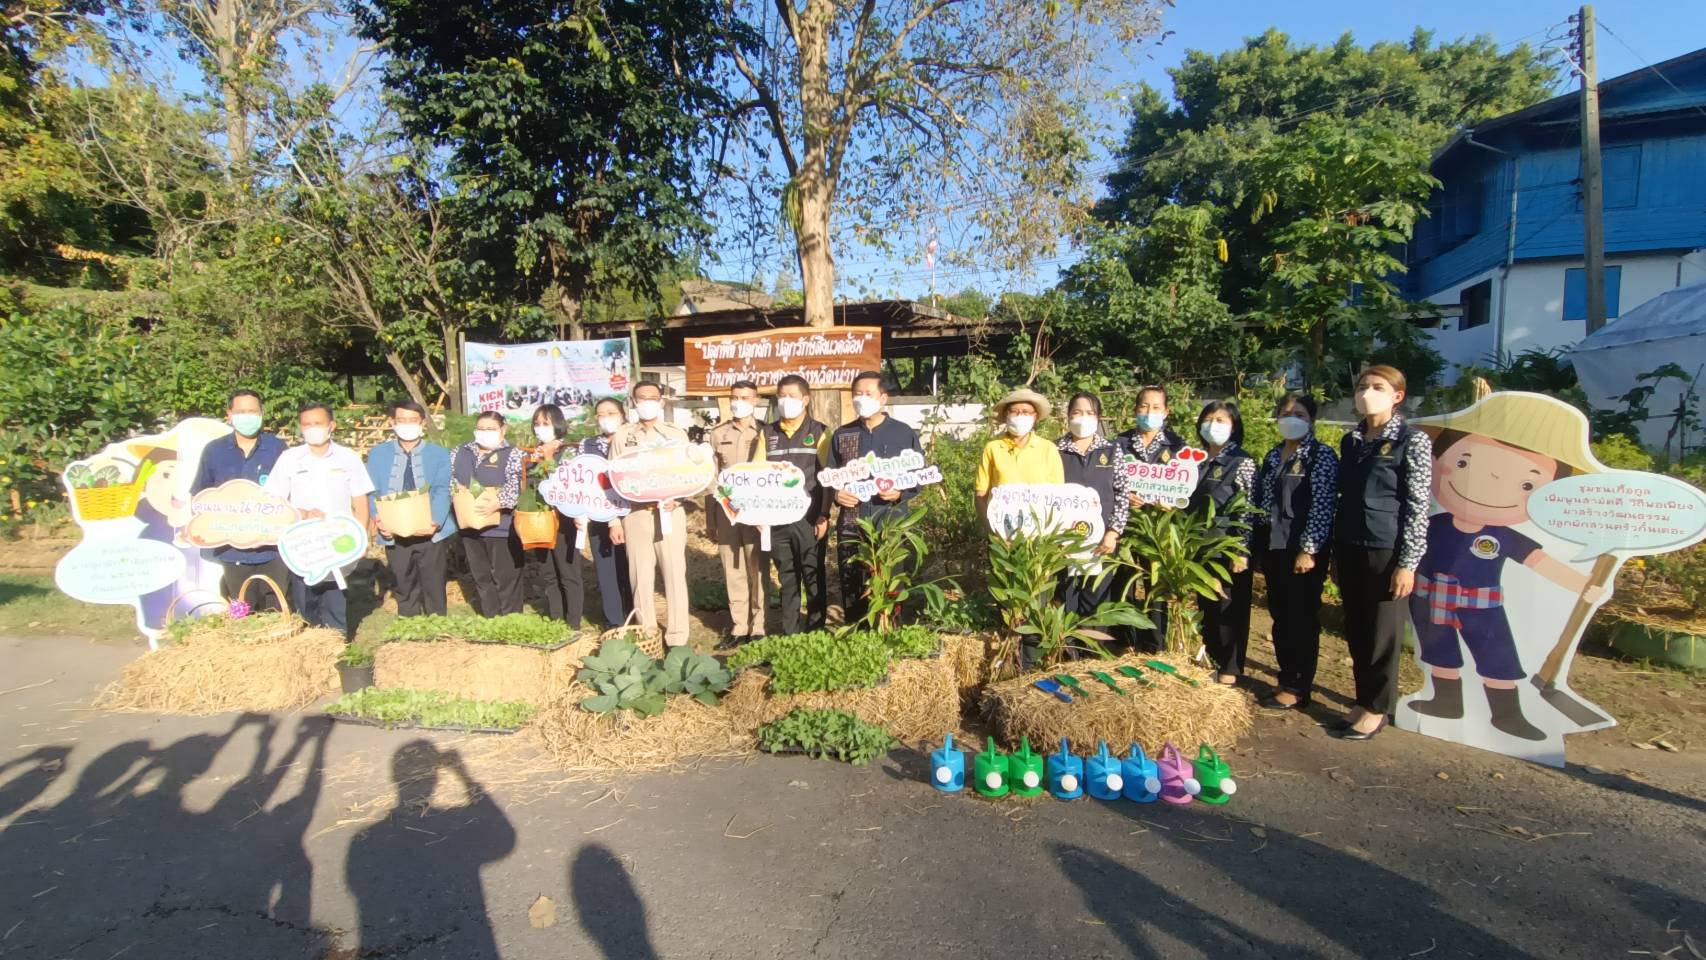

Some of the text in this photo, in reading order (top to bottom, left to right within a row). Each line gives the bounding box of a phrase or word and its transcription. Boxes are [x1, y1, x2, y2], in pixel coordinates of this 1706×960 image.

[479, 387, 505, 404] KICK
[558, 461, 595, 489] ผู้นำ
[756, 472, 783, 487] off
[1127, 461, 1190, 483] ฮอมฮัก
